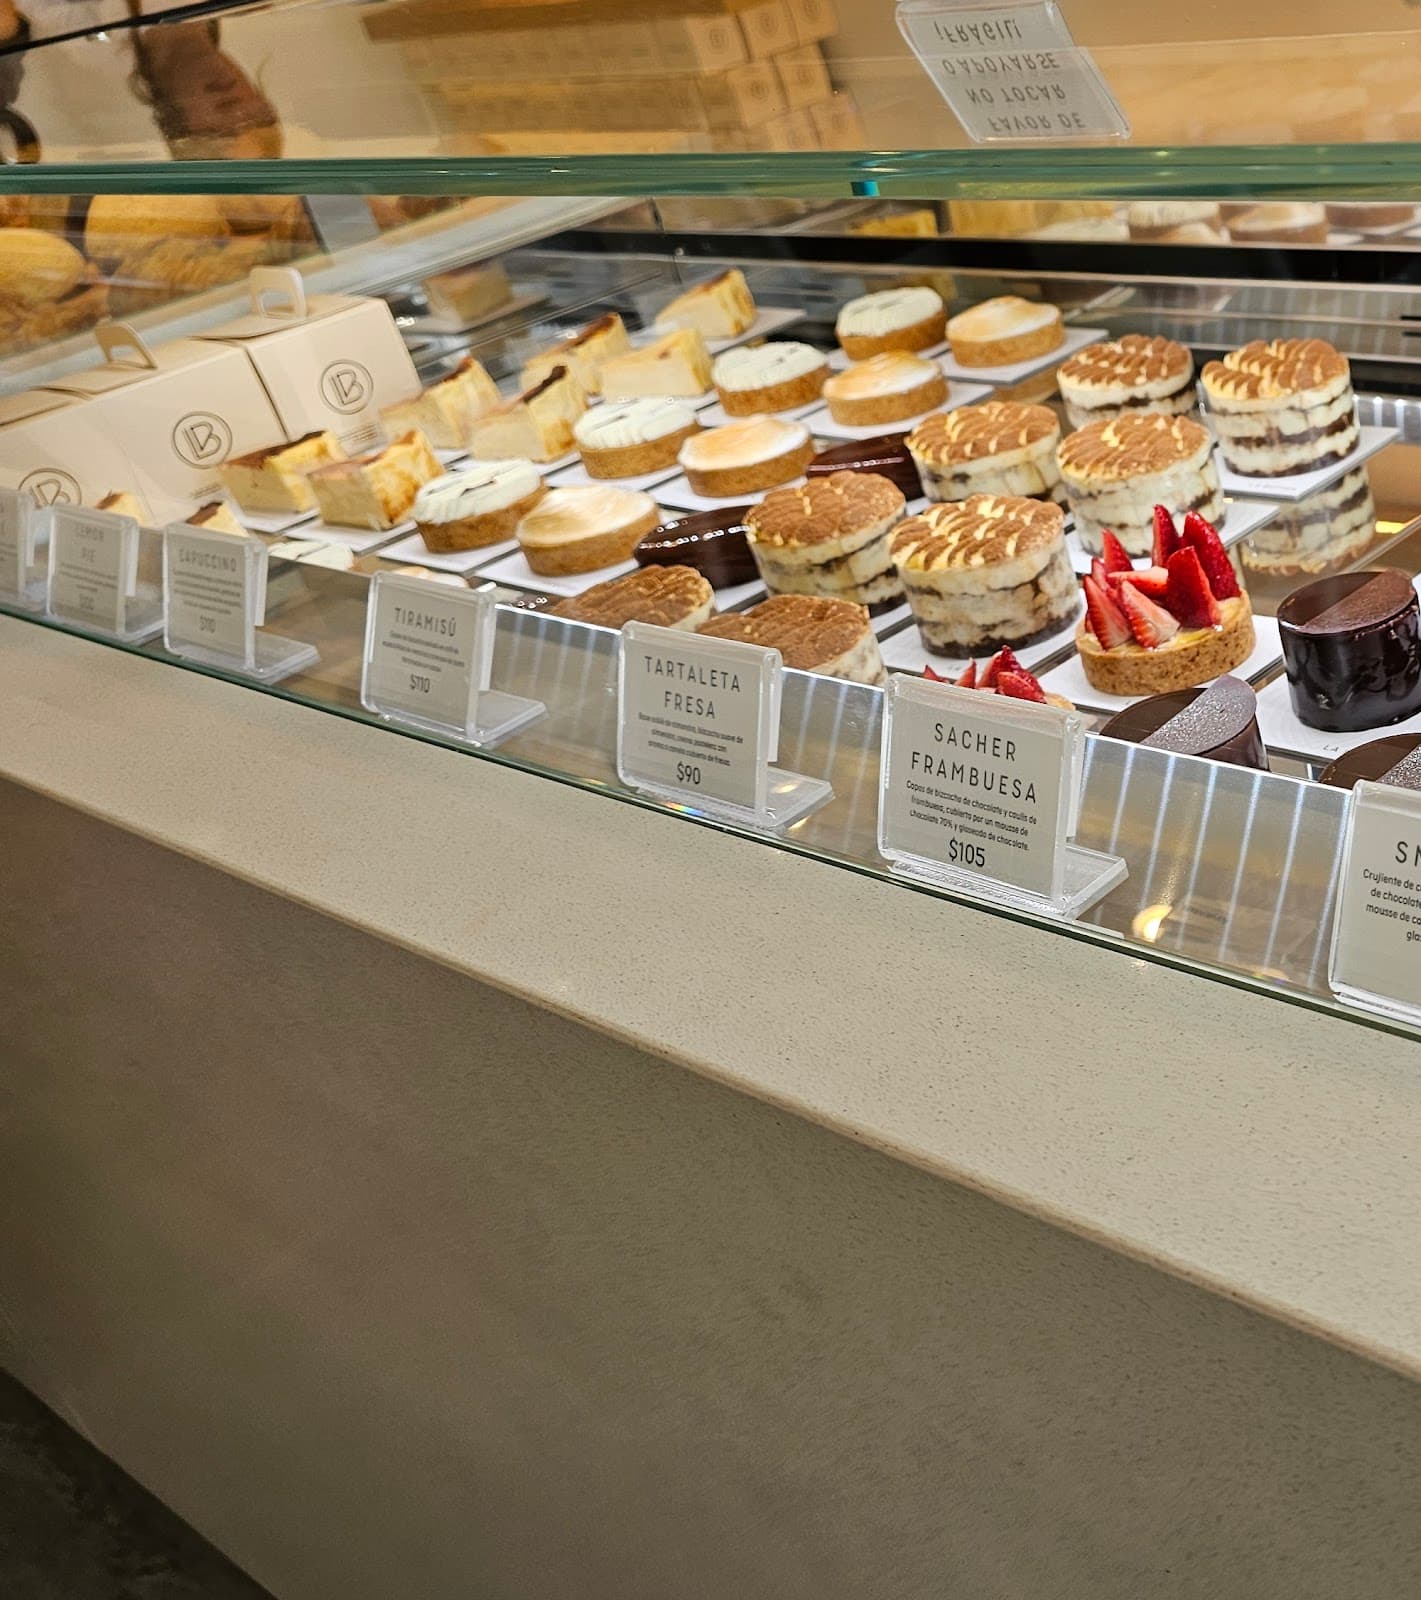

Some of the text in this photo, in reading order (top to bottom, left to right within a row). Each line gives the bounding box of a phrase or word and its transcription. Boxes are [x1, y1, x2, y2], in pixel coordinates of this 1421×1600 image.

[394, 607, 457, 637] TIRAMISÚ
[409, 673, 431, 694] $110
[643, 655, 742, 693] TARTALETA
[664, 690, 716, 719] FRESA
[934, 722, 1016, 762] SACHER
[676, 760, 701, 786] $90
[911, 751, 1036, 804] FRAMBUESA
[972, 800, 1003, 815] chocolate
[1028, 815, 1038, 825] de
[1020, 827, 1029, 837] de
[948, 835, 986, 868] $105
[1362, 868, 1402, 887] Crujiente
[1402, 879, 1414, 890] de
[1370, 888, 1381, 899] de
[1365, 903, 1399, 919] mousse
[1399, 912, 1411, 923] de
